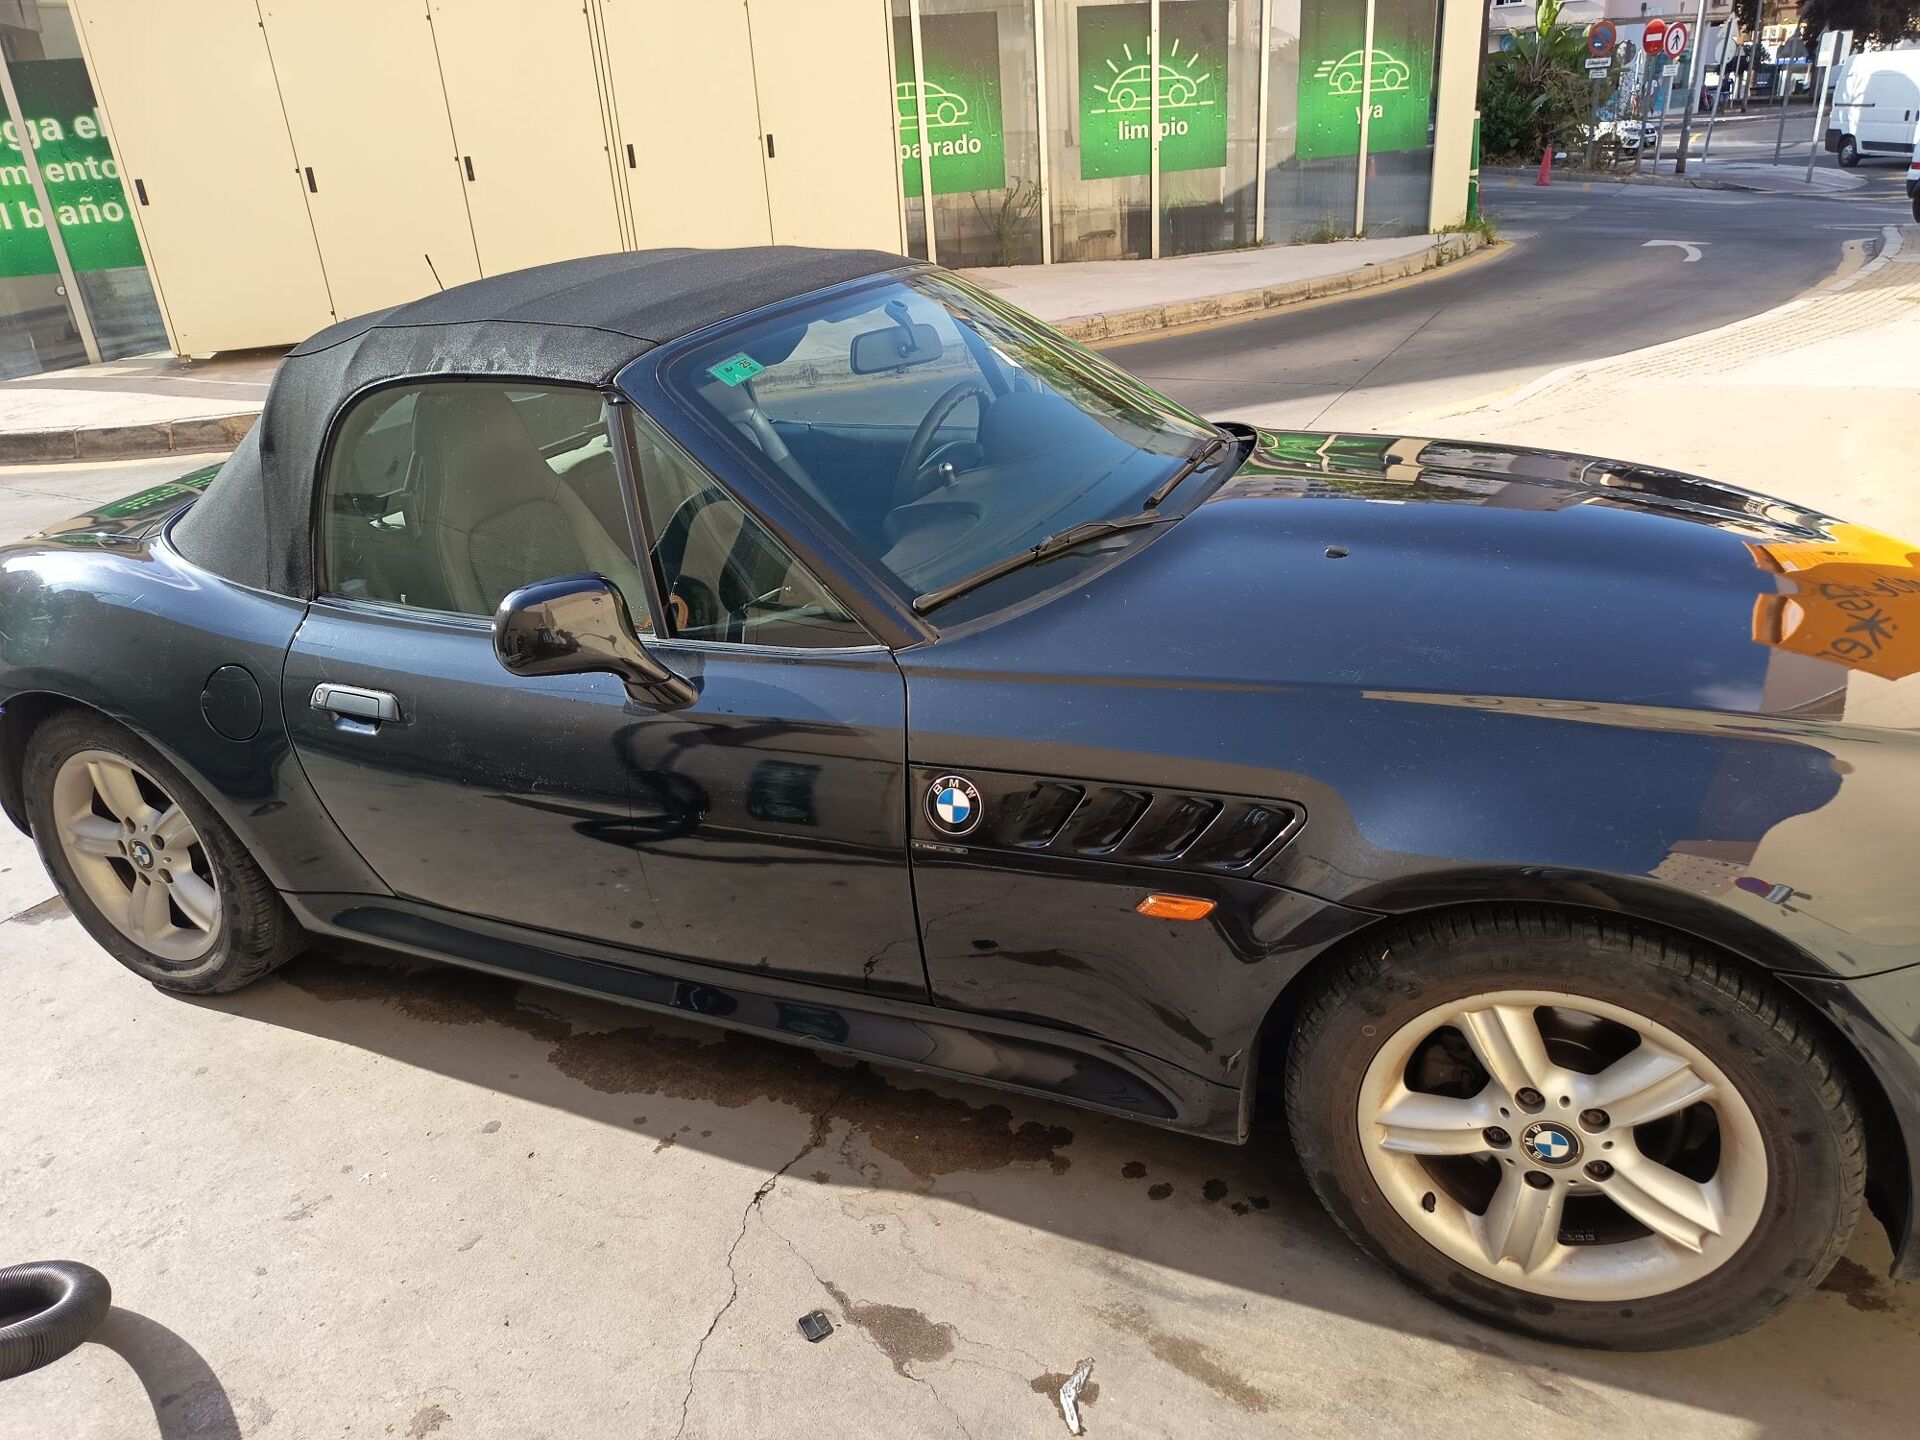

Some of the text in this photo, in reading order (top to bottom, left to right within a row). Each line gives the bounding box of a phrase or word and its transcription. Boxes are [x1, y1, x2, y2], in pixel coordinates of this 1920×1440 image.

[0, 107, 108, 150] ga el
[1118, 116, 1188, 141] limpio
[0, 156, 121, 185] mento
[19, 195, 124, 229] baño
[932, 779, 977, 799] BMW
[1524, 1124, 1543, 1159] BMW
